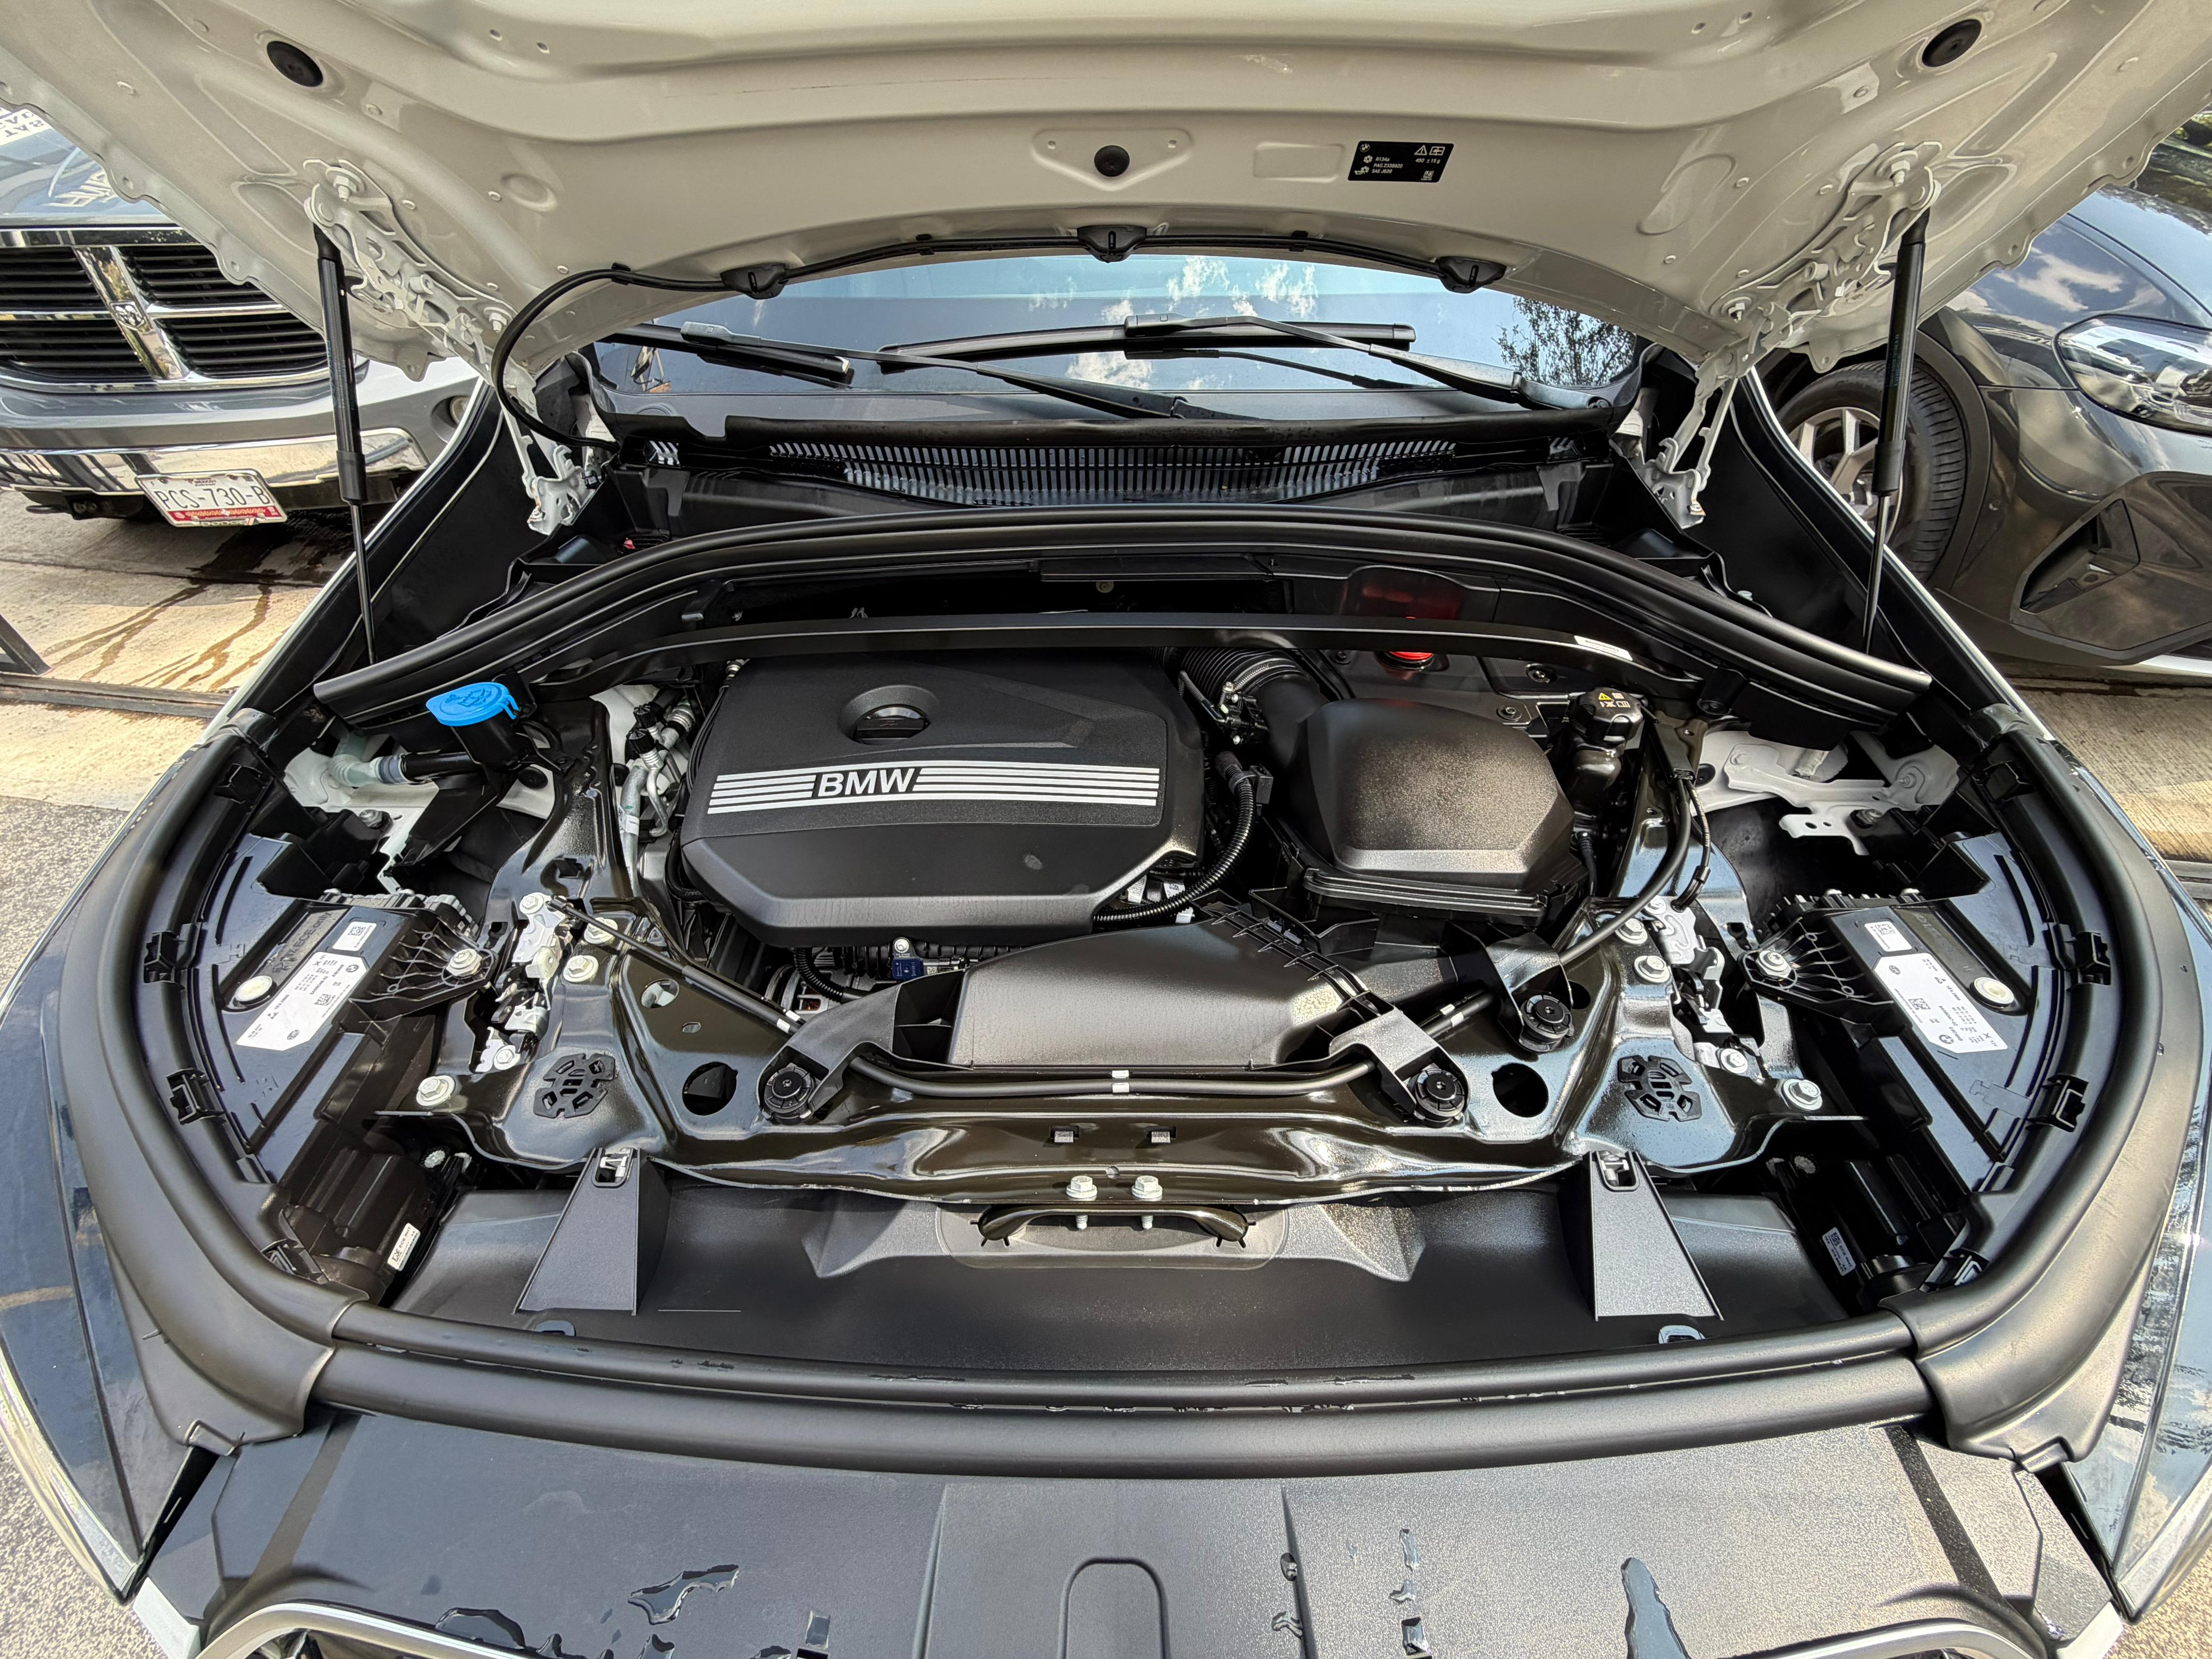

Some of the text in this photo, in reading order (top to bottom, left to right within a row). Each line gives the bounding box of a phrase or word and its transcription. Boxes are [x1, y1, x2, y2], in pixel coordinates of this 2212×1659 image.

[153, 485, 271, 509] PCS-730-B
[818, 768, 915, 797] BMW
[292, 912, 332, 948] ECE only
